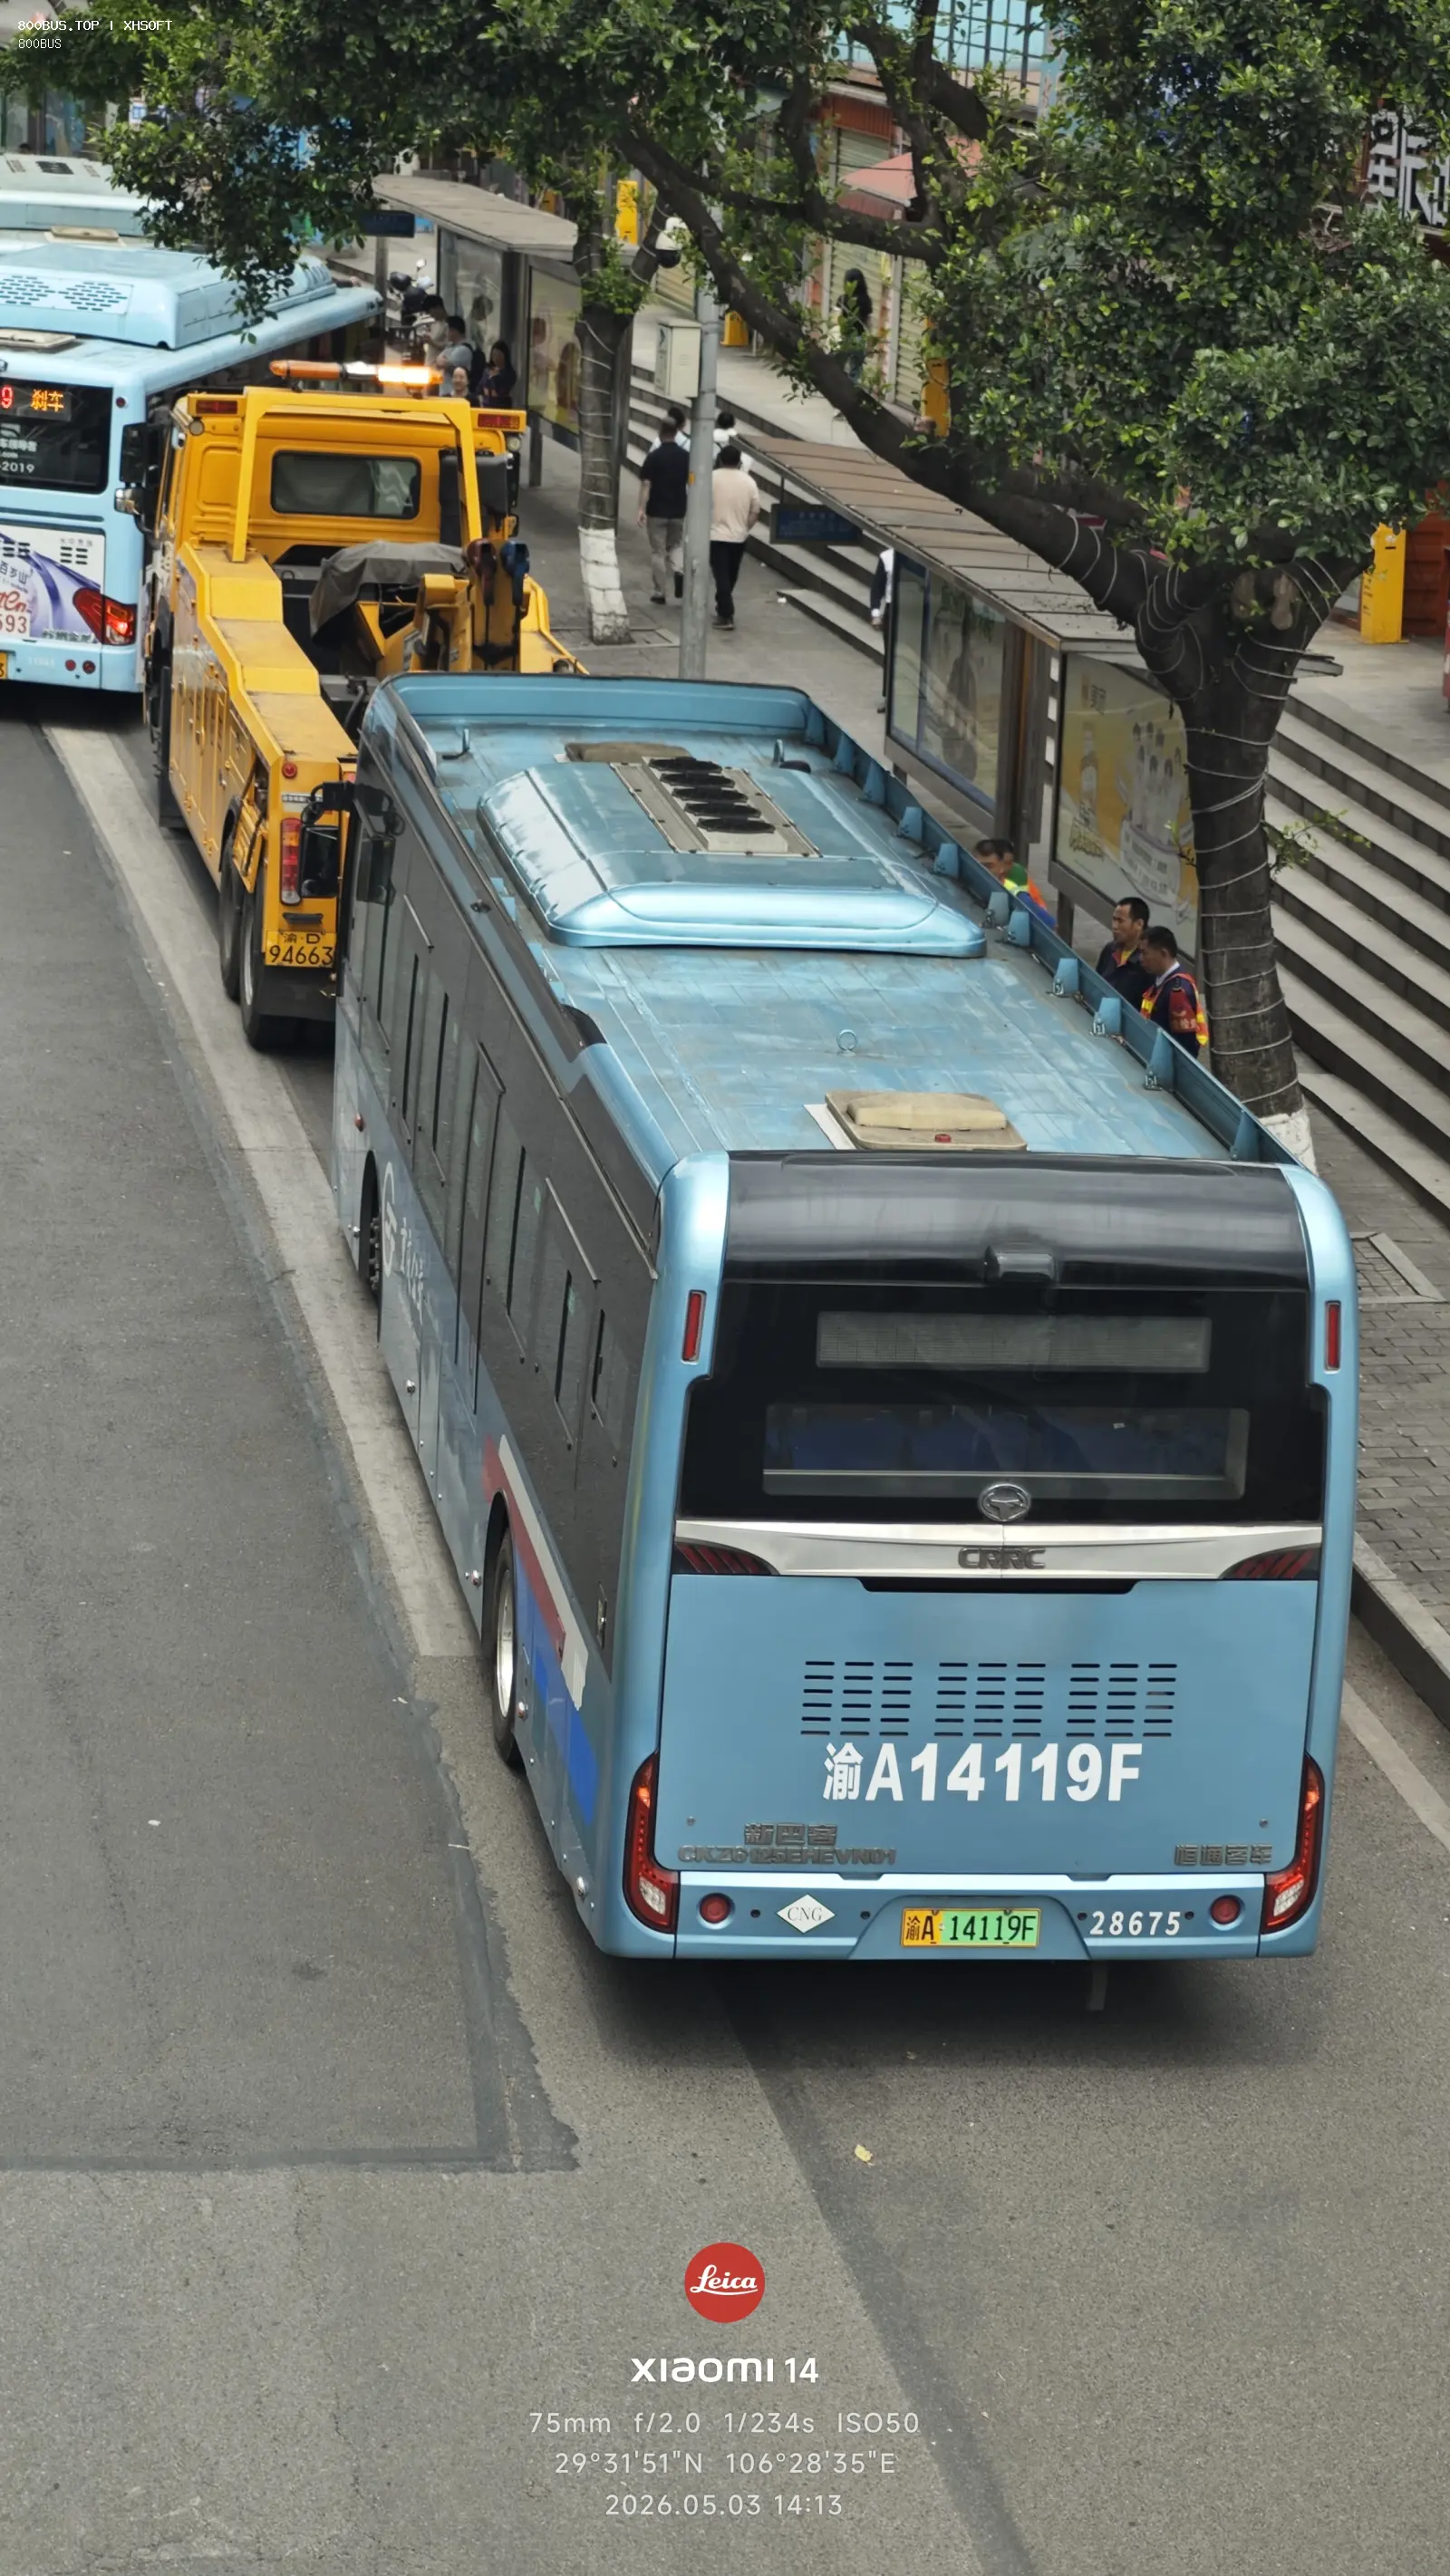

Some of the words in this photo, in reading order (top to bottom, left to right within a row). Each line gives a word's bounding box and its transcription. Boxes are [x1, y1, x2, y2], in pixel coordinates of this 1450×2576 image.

[268, 945, 334, 965] 94663
[958, 1548, 1046, 1569] CRRC
[823, 1742, 1143, 1802] 渝A14119F
[744, 1823, 837, 1846] 新巴客
[1174, 1844, 1273, 1866] 恒通客车
[787, 1906, 823, 1921] CNG
[1089, 1910, 1181, 1935] 28675
